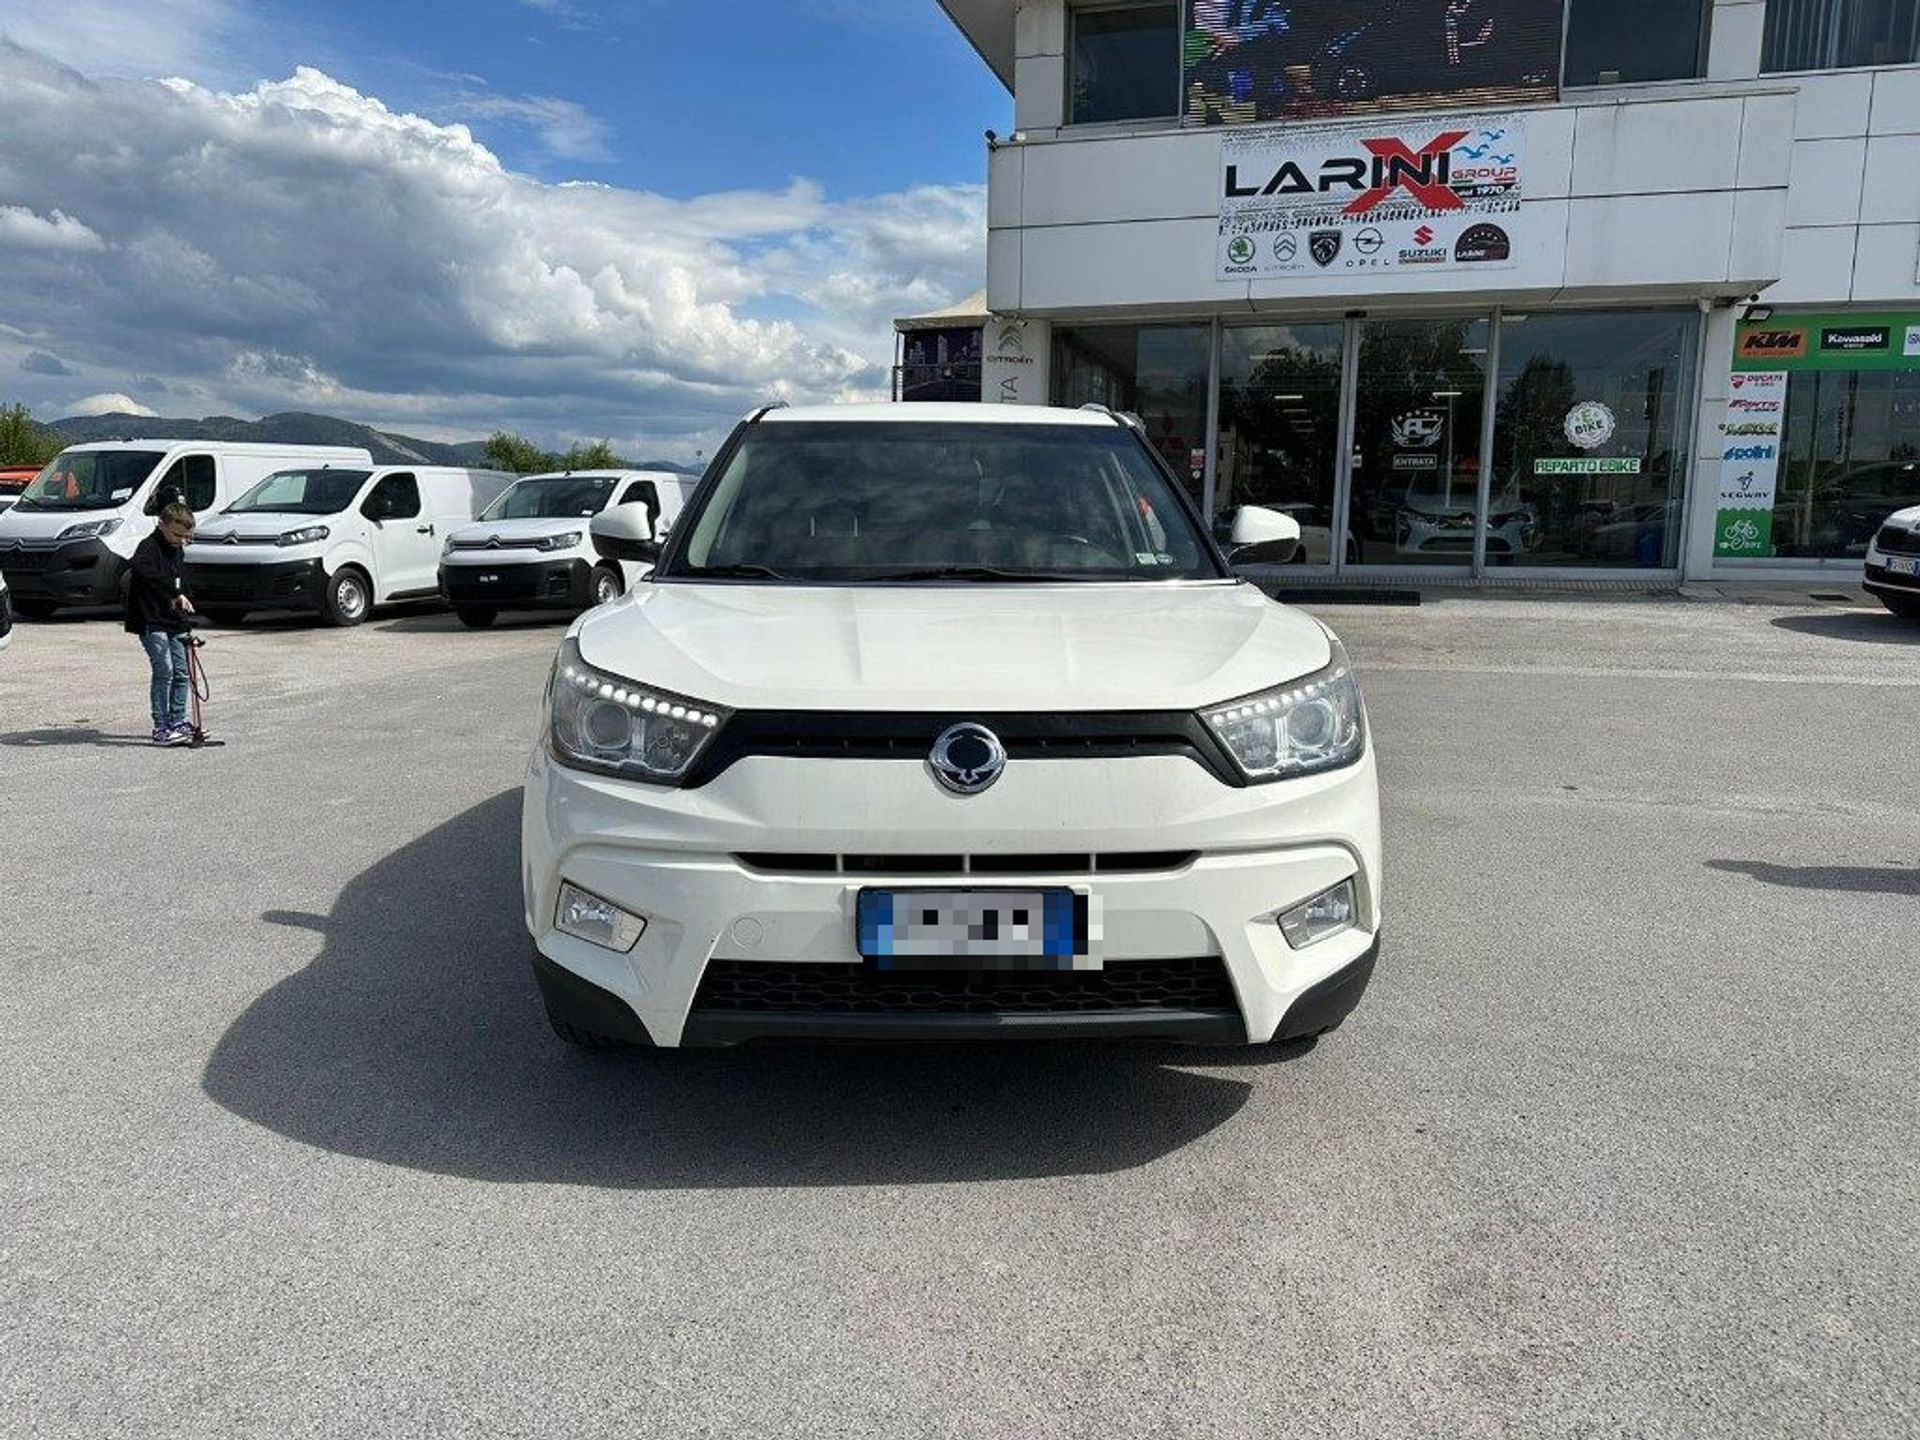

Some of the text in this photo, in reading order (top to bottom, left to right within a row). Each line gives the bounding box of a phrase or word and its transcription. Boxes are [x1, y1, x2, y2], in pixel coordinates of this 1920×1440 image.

[1225, 151, 1450, 197] LARINI
[1451, 166, 1517, 179] GROUP
[1398, 248, 1447, 258] SUZUKI
[1346, 258, 1391, 267] OPEL
[1743, 331, 1802, 348] KTM
[1827, 333, 1883, 343] Kawasaki
[1575, 420, 1605, 435] BIKE
[1396, 457, 1434, 467] ENTRATA
[1535, 460, 1597, 472] REPARTO
